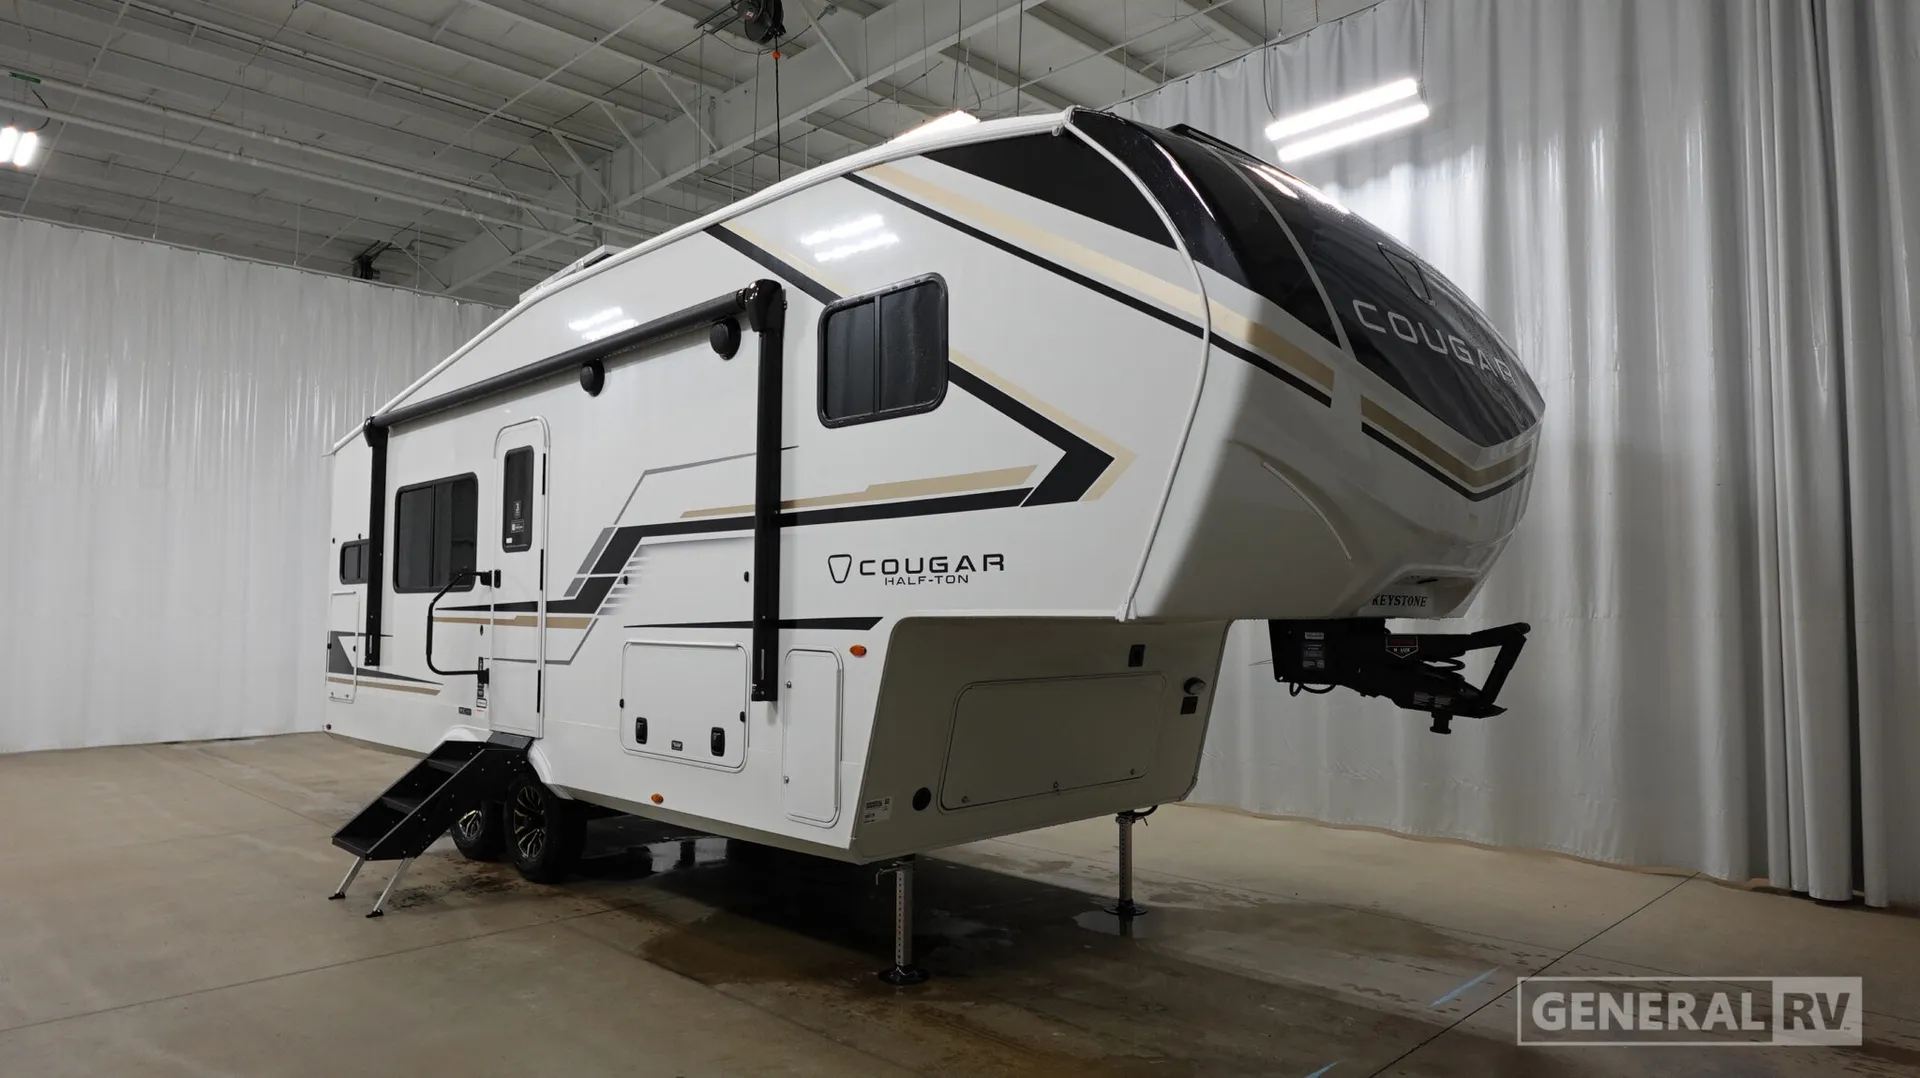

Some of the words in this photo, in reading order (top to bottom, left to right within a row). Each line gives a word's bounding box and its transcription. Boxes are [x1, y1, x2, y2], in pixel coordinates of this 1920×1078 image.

[1353, 300, 1516, 385] COUGAR
[859, 554, 1004, 575] COUGAR
[885, 574, 969, 586] HALF-TON
[1371, 594, 1428, 607] KEYSTONE
